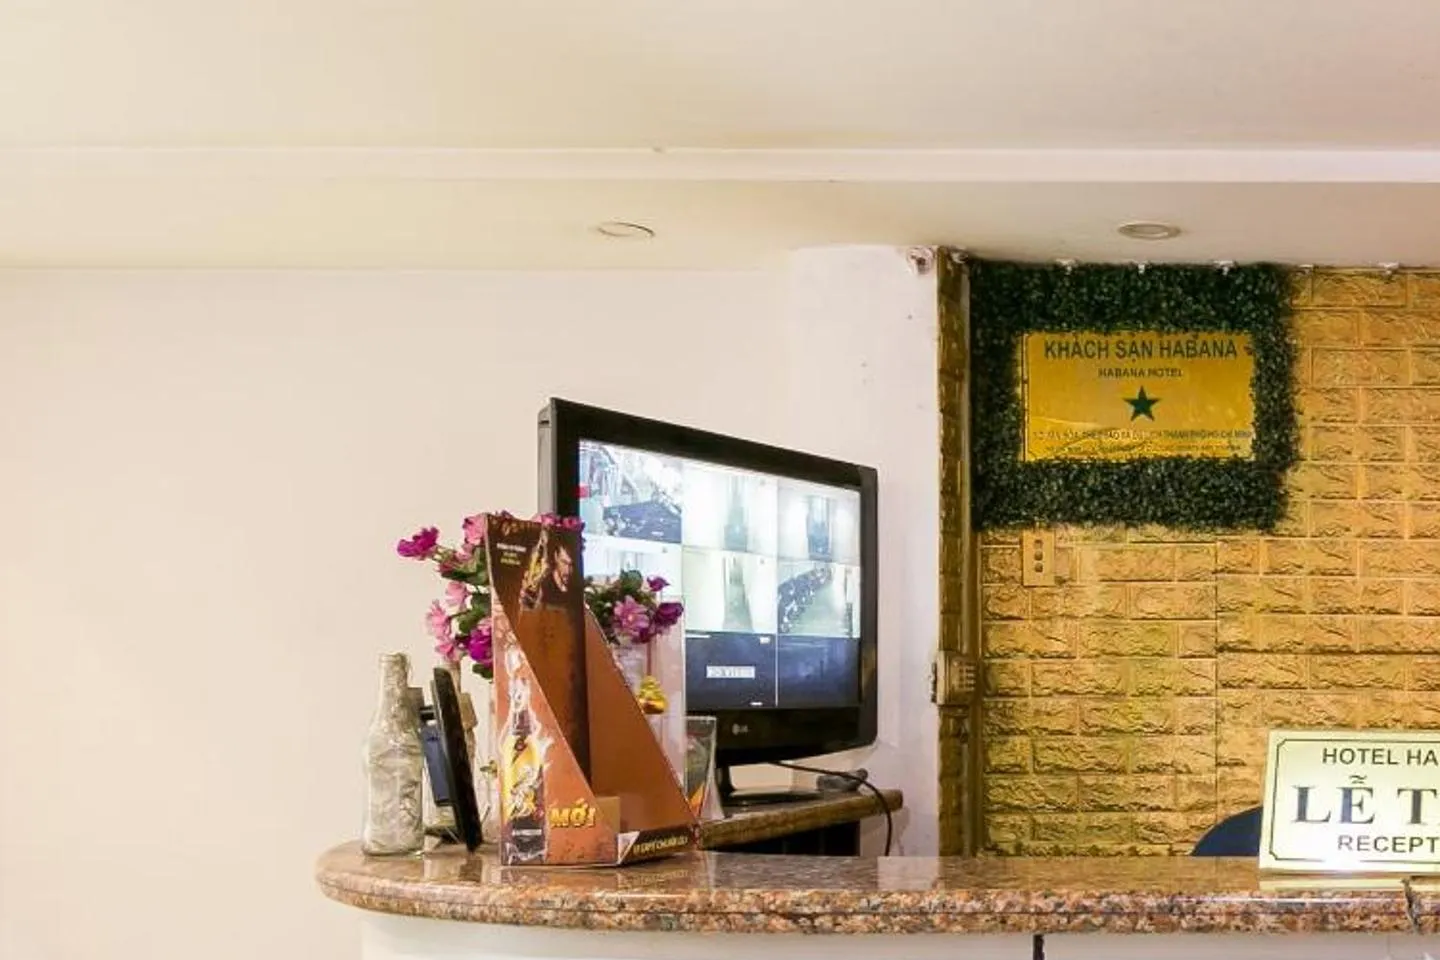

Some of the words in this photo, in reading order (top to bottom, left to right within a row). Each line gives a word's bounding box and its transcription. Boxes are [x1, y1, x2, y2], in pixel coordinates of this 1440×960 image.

[1159, 340, 1237, 359] HABANA
[1098, 368, 1145, 378] HABANA
[1149, 368, 1183, 378] HOTEL
[1322, 748, 1399, 766] HOTEL
